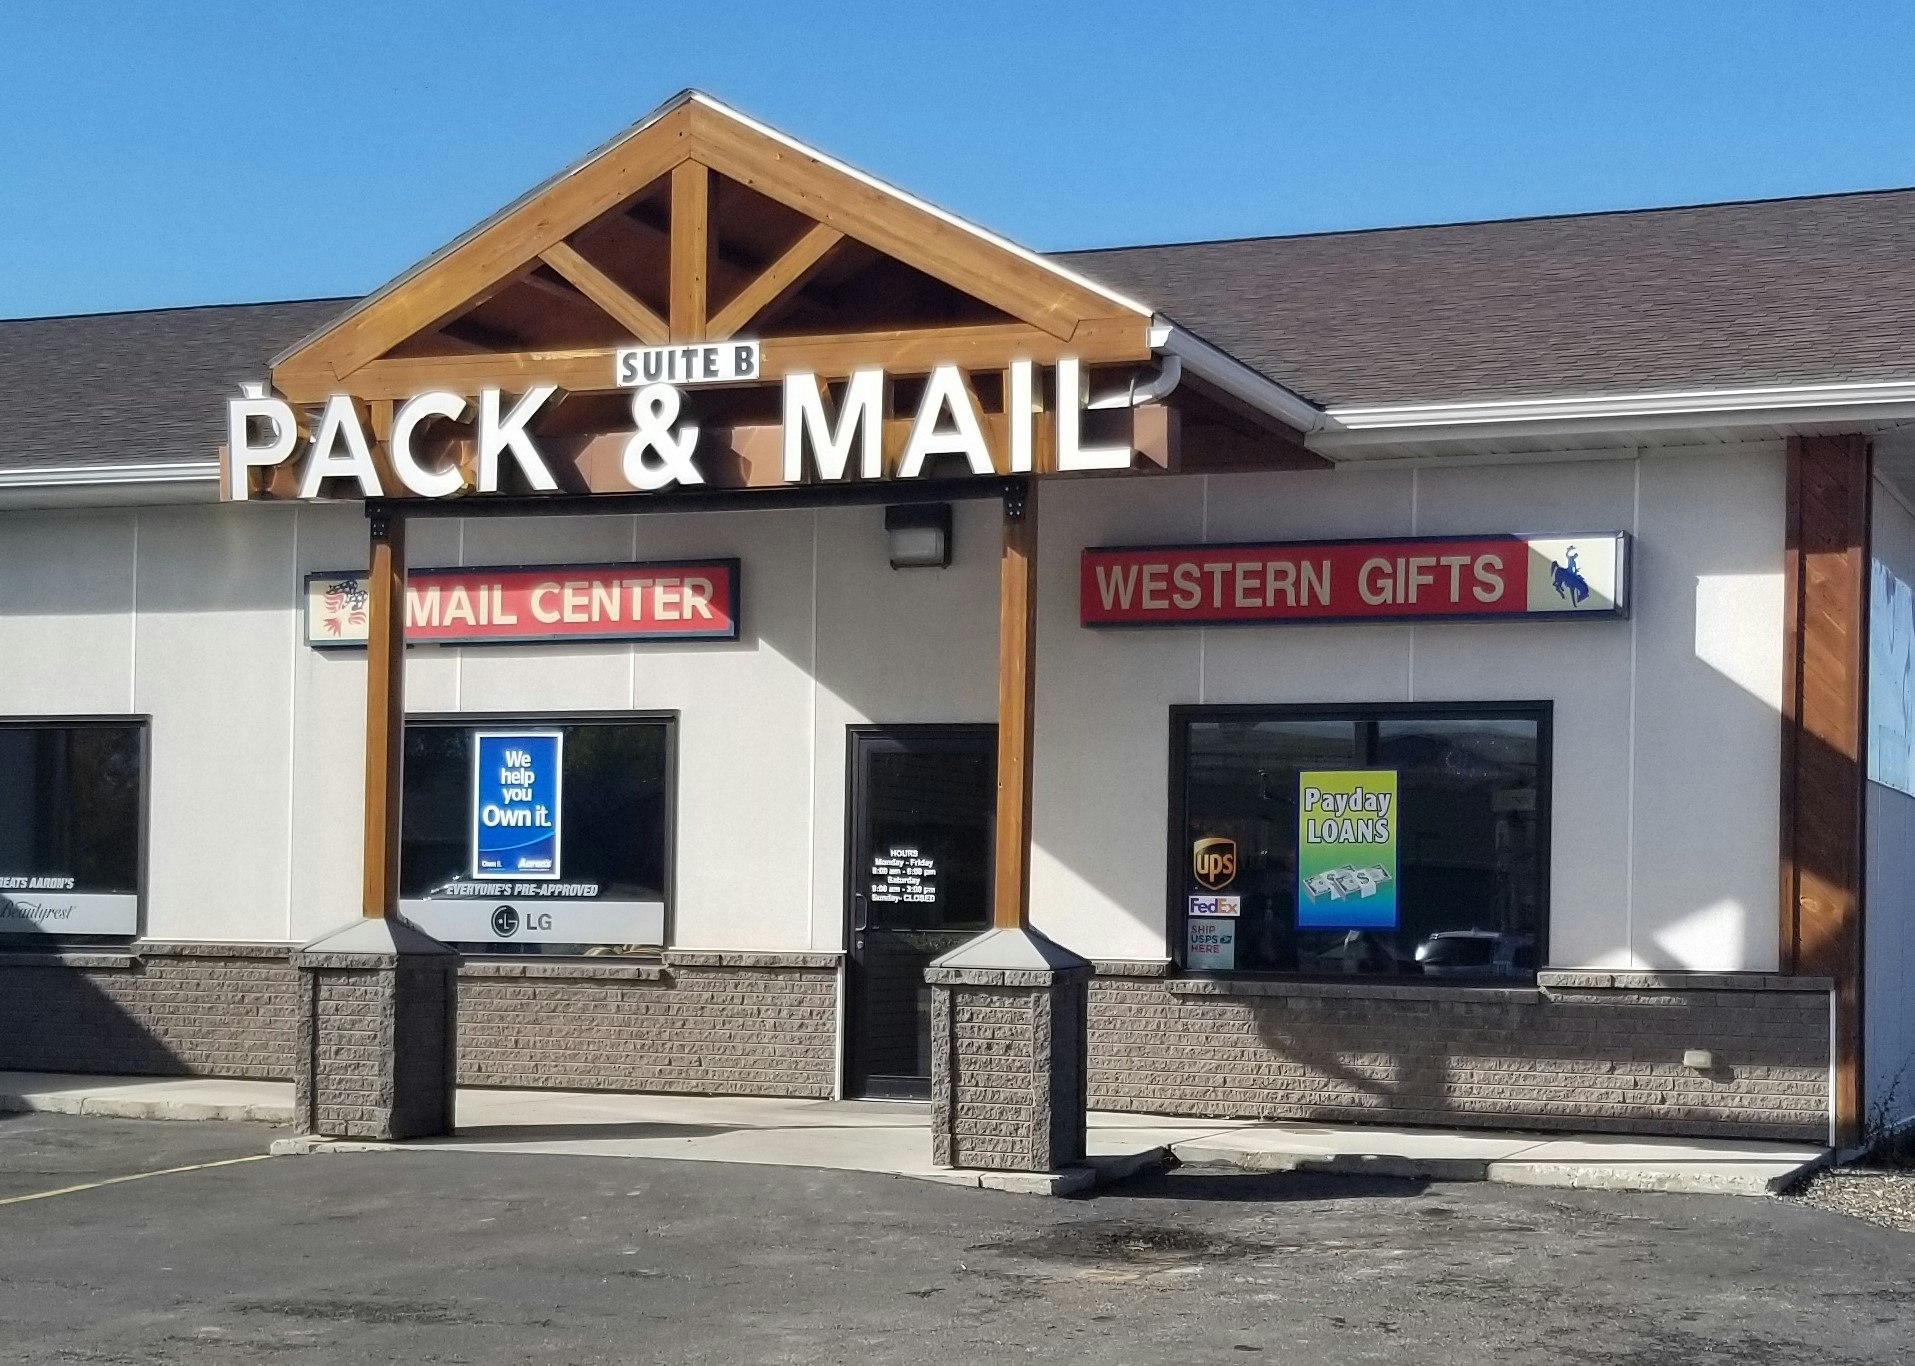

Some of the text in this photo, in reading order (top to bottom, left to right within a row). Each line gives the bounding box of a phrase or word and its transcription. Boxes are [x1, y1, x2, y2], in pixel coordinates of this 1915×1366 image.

[622, 346, 755, 383] SUITE B
[228, 358, 1131, 501] PACK & MAIL
[1096, 554, 1506, 611] WESTERN GIFTS
[405, 576, 714, 627] MAIL CENTER
[505, 750, 532, 768] We
[501, 768, 535, 788] help
[502, 788, 533, 804] you
[1304, 786, 1392, 818] Payday
[482, 804, 552, 827] Own it.
[1306, 818, 1390, 844] LOANS
[890, 849, 919, 857] HOURS
[875, 858, 904, 868] Monday
[910, 859, 934, 868] Friday
[1197, 854, 1233, 882] ups
[28, 877, 75, 890] AARON'S
[887, 876, 920, 886] Saturday
[447, 883, 598, 897] EVERYONE'S PRE-APPROVED
[903, 894, 936, 902] CLOSED
[1190, 897, 1238, 914] FedEx
[526, 913, 552, 931] LG
[1191, 925, 1216, 935] SHIP
[1191, 935, 1218, 944] USPS
[1191, 944, 1220, 953] HERE
